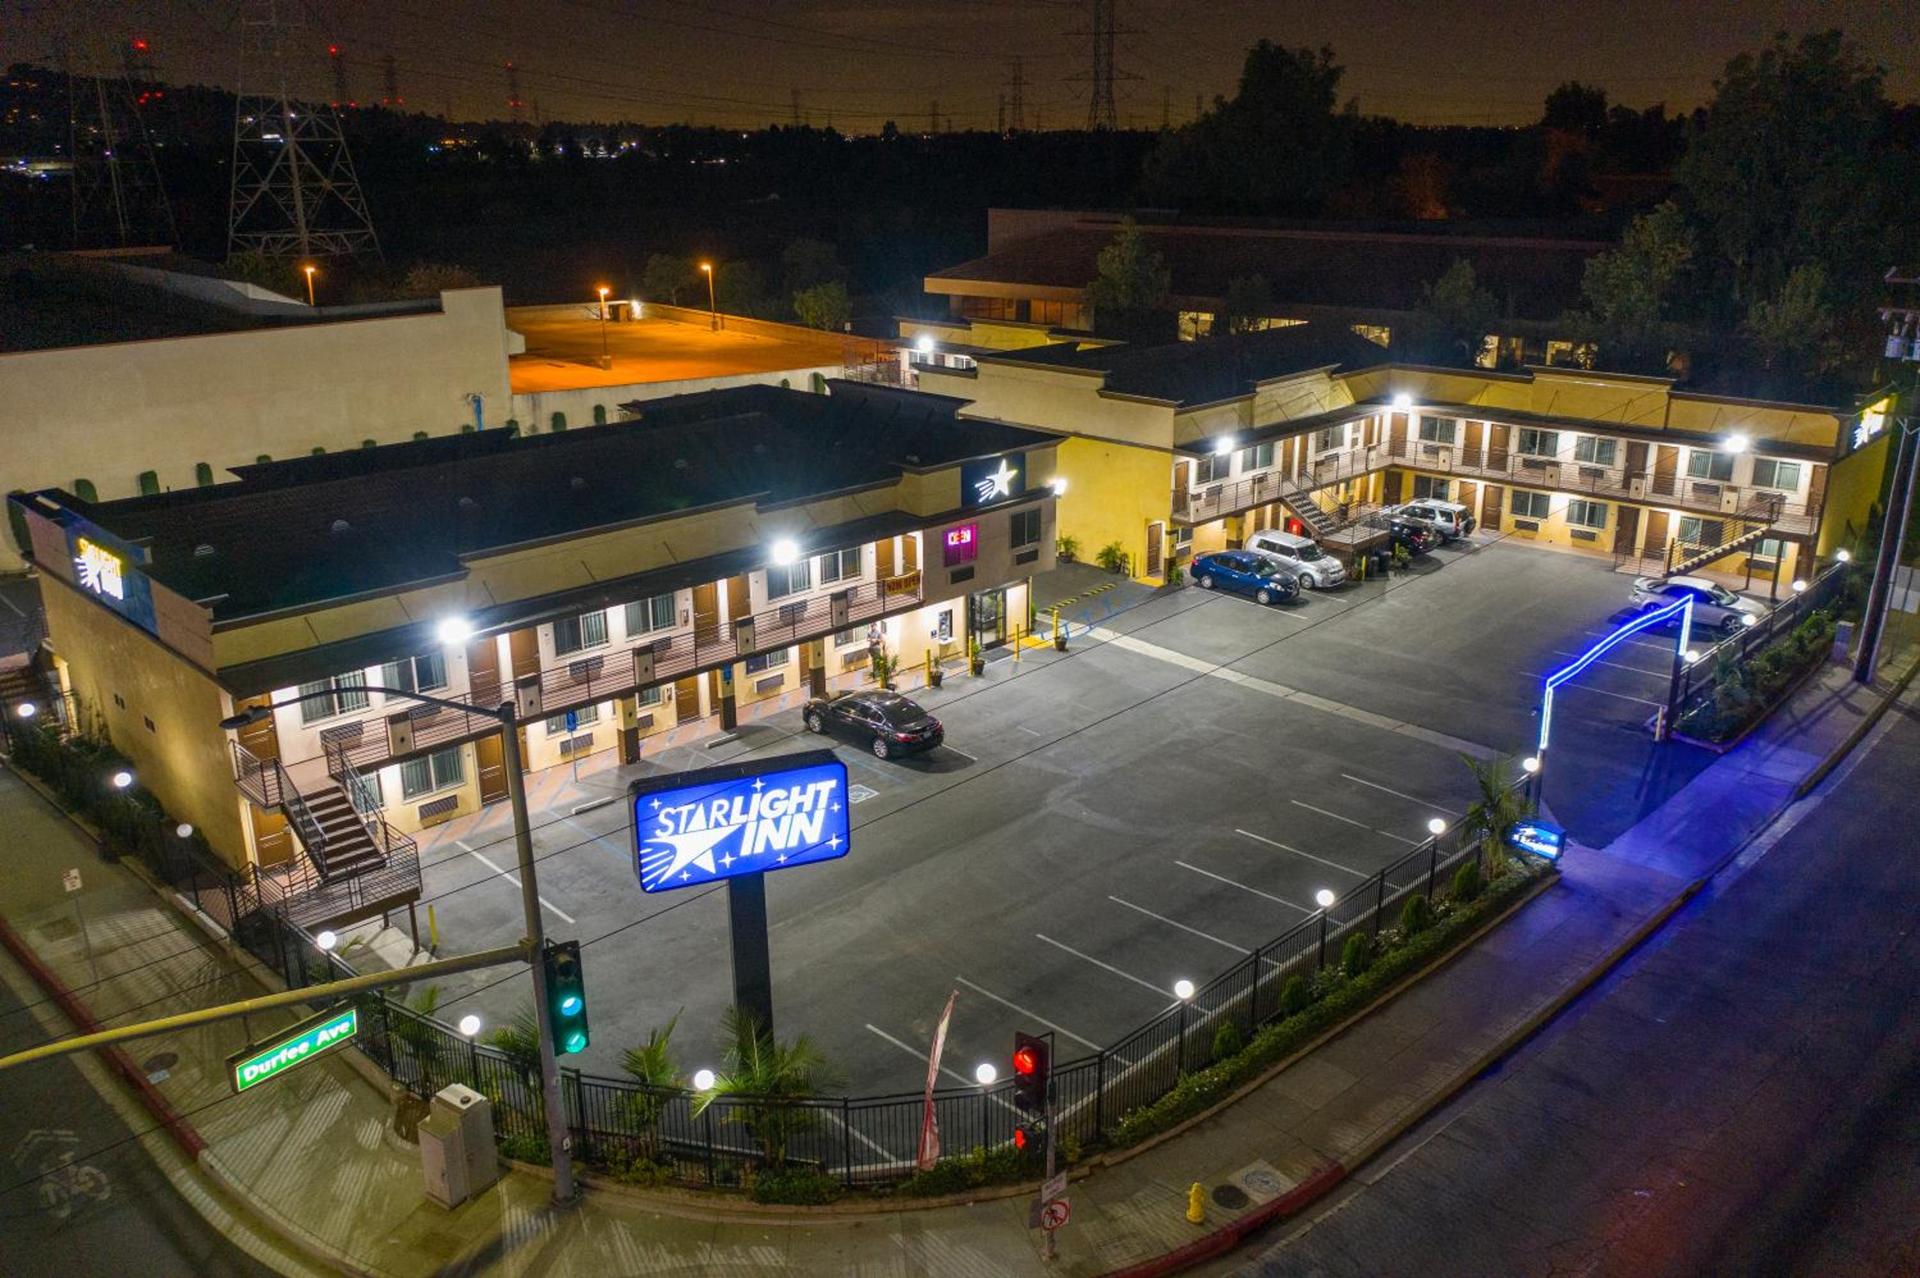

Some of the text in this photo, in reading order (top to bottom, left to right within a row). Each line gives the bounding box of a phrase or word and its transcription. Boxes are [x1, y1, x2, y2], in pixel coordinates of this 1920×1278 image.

[655, 779, 838, 837] STARLIGHT
[740, 811, 825, 857] INN
[243, 1020, 350, 1082] Durfee Ave
